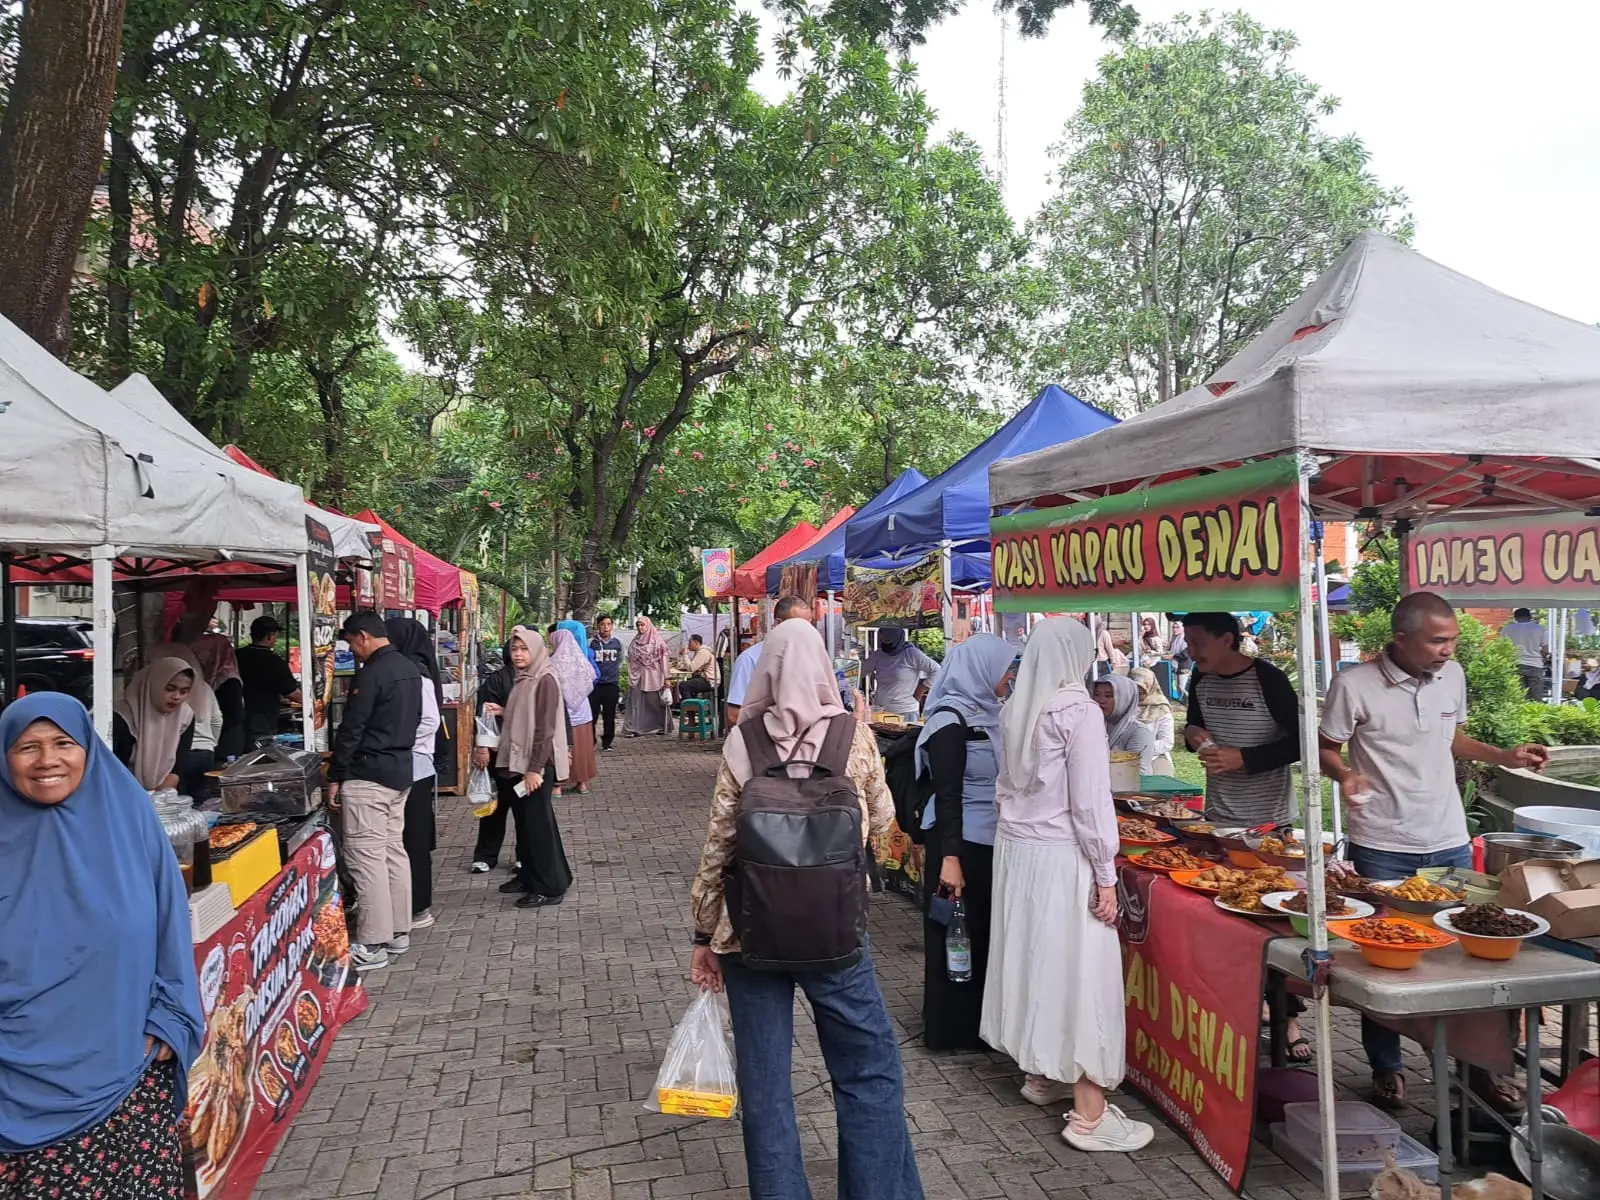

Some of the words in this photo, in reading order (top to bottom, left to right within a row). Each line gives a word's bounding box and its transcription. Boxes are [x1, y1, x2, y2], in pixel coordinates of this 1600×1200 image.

[994, 535, 1045, 589] NASI
[1050, 519, 1145, 588] KAPAU
[1157, 497, 1282, 582] DENAI
[251, 872, 308, 979] TAKOYAKI
[245, 957, 287, 1046] DIMSUM
[1170, 981, 1247, 1101] DENAI
[1135, 1027, 1204, 1115] PADANG
